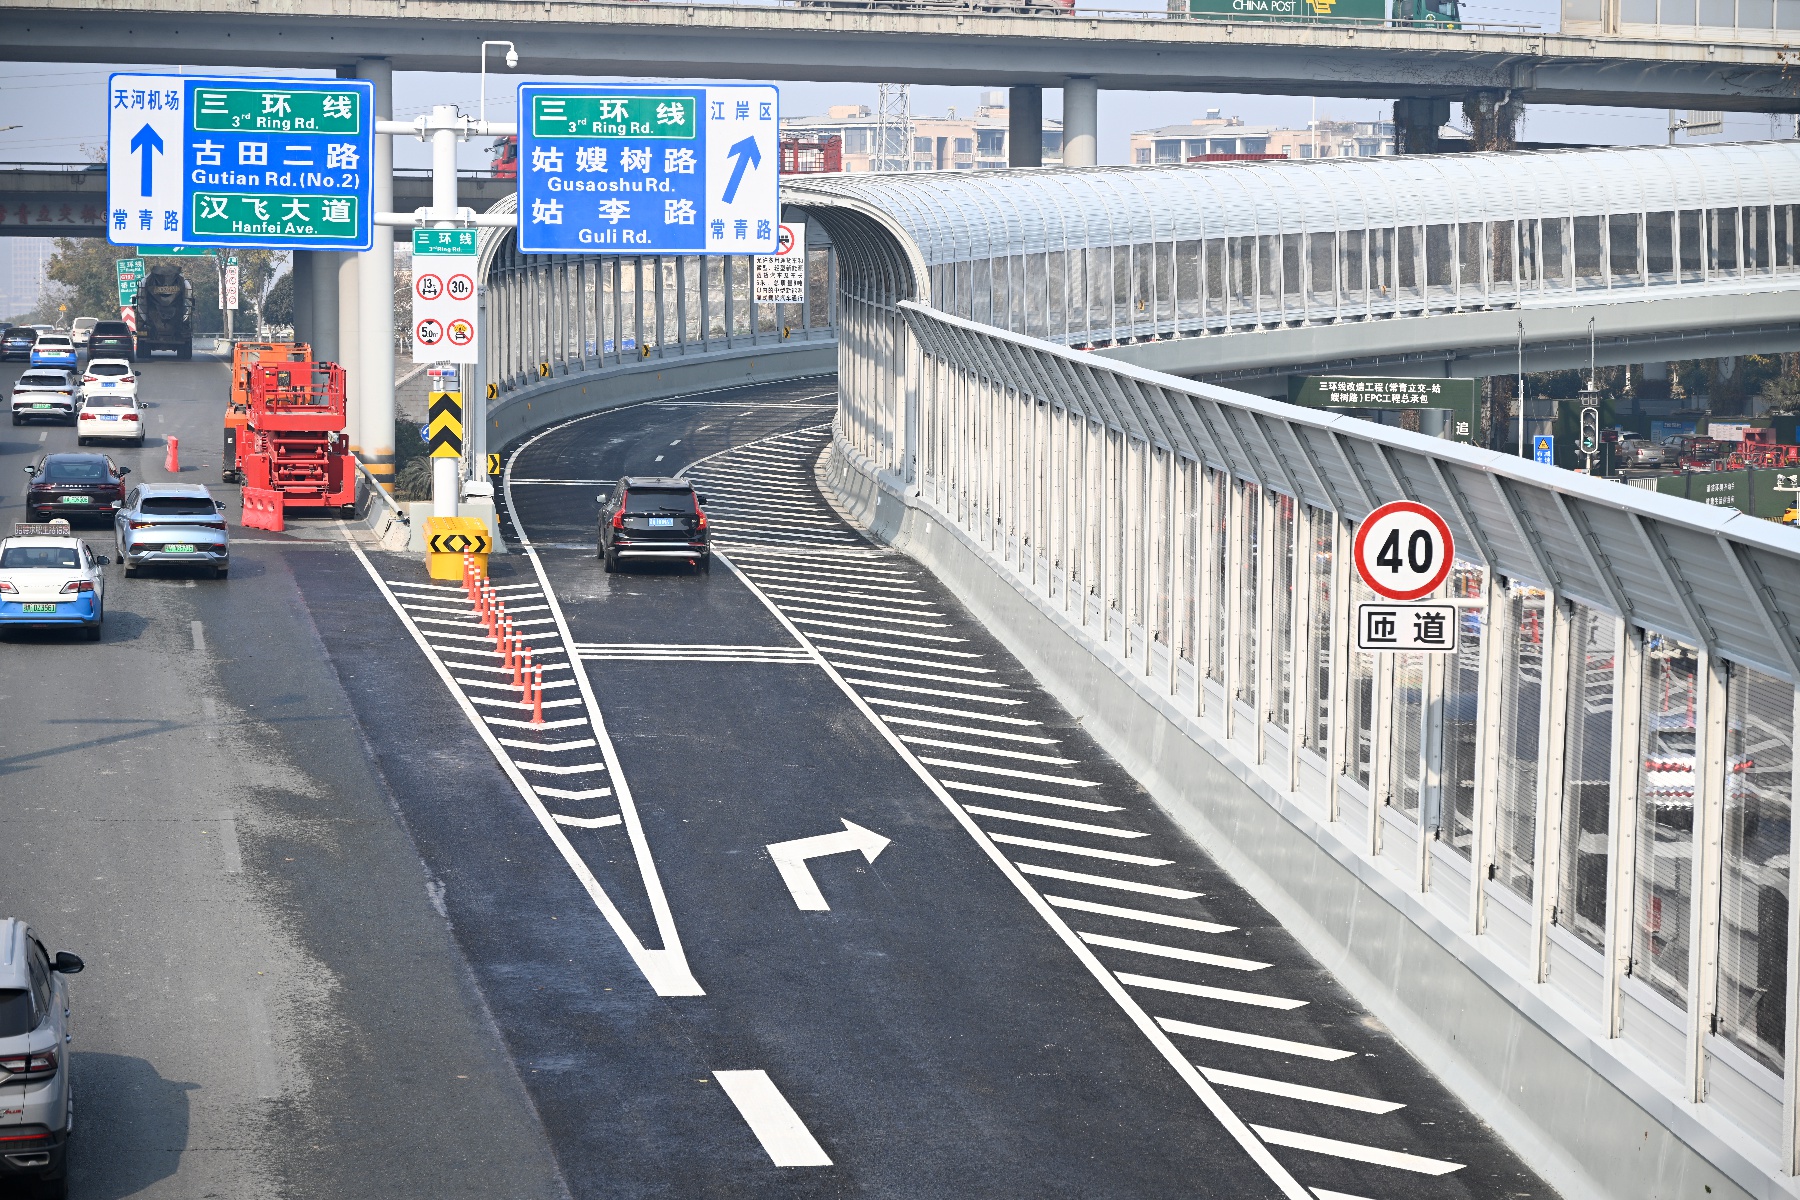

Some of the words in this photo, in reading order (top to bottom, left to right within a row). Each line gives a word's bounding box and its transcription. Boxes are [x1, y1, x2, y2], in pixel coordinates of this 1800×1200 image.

[1233, 0, 1268, 11] CHINA
[1271, 1, 1296, 12] POST
[114, 89, 179, 111] 天河机场
[201, 93, 352, 120] 三环线
[711, 101, 772, 121] 江岸区
[232, 113, 251, 127] 3rd
[256, 117, 291, 131] Ring
[295, 117, 319, 130] Rd.
[540, 99, 685, 126] 三环线
[568, 118, 587, 133] 3rd
[592, 121, 626, 135] Ring
[630, 122, 654, 134] Rd.
[192, 139, 360, 169] 古田二路
[531, 146, 697, 174] 姑嫂树路
[192, 169, 260, 186] Gutian
[547, 177, 642, 192] Gusaoshu
[645, 178, 676, 192] Rd.
[112, 209, 179, 232] 常青路
[199, 196, 351, 223] 汉飞大道
[531, 198, 697, 225] 姑李路
[232, 221, 282, 234] Hanfei
[285, 221, 318, 235] Ave.
[418, 233, 472, 245] 三环线
[578, 228, 617, 244] Guli
[622, 229, 652, 244] Rd.
[711, 219, 772, 241] 常青路
[452, 281, 468, 293] 30t
[1376, 528, 1433, 574] 40
[1367, 611, 1446, 644] 匝道
